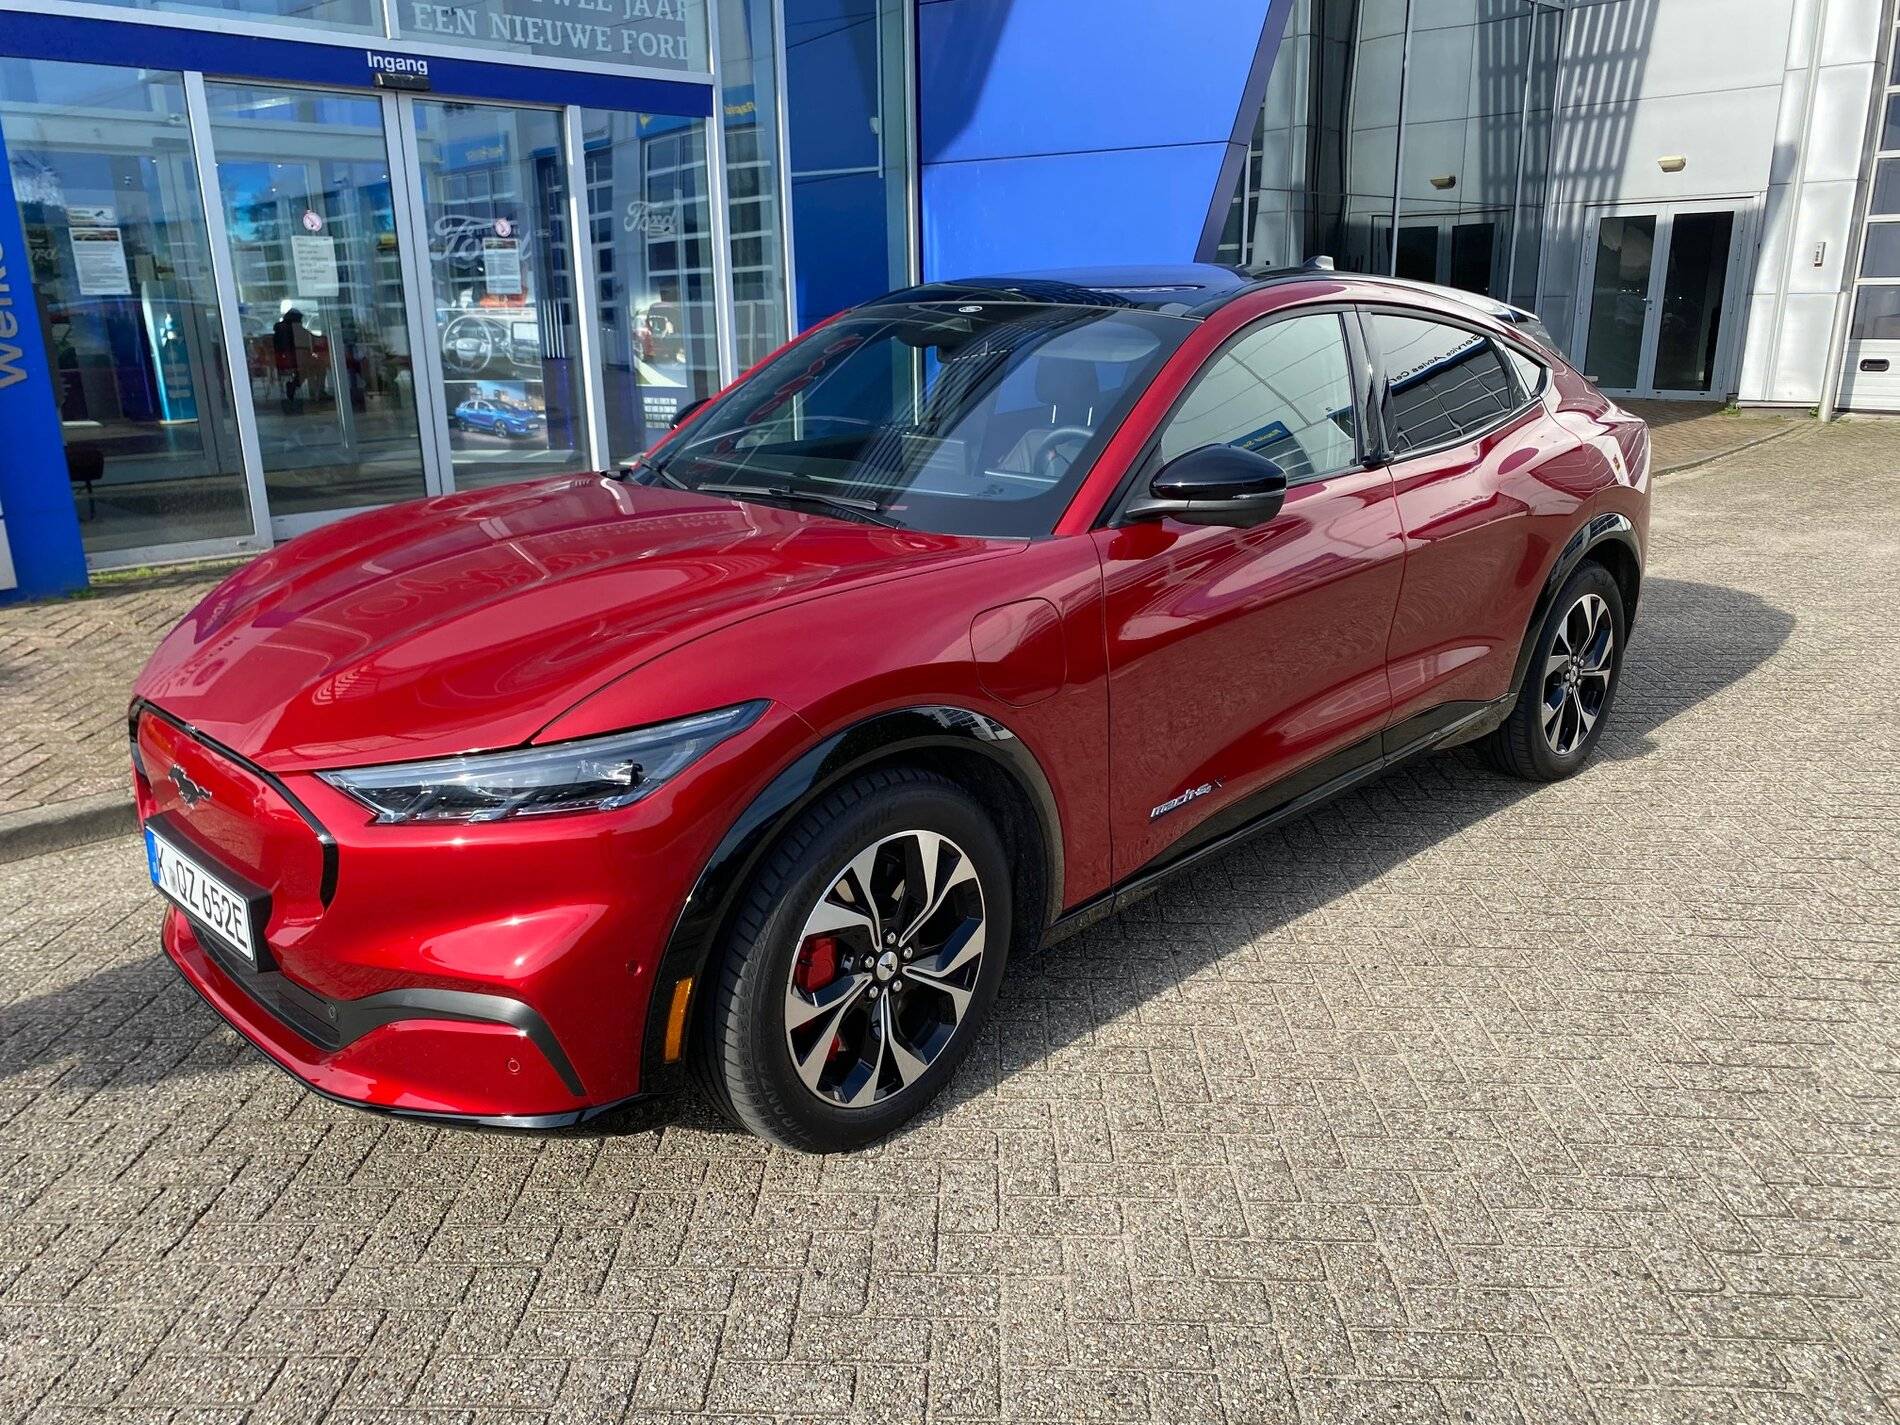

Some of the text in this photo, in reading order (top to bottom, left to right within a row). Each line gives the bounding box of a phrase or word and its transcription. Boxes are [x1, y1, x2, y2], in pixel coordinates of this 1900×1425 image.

[411, 2, 693, 60] EEN NIEUWE FORD
[367, 51, 429, 75] Ingang
[429, 215, 532, 261] Fod
[624, 200, 678, 232] Ford
[176, 860, 199, 910] QZ
[202, 880, 248, 949] 652E
